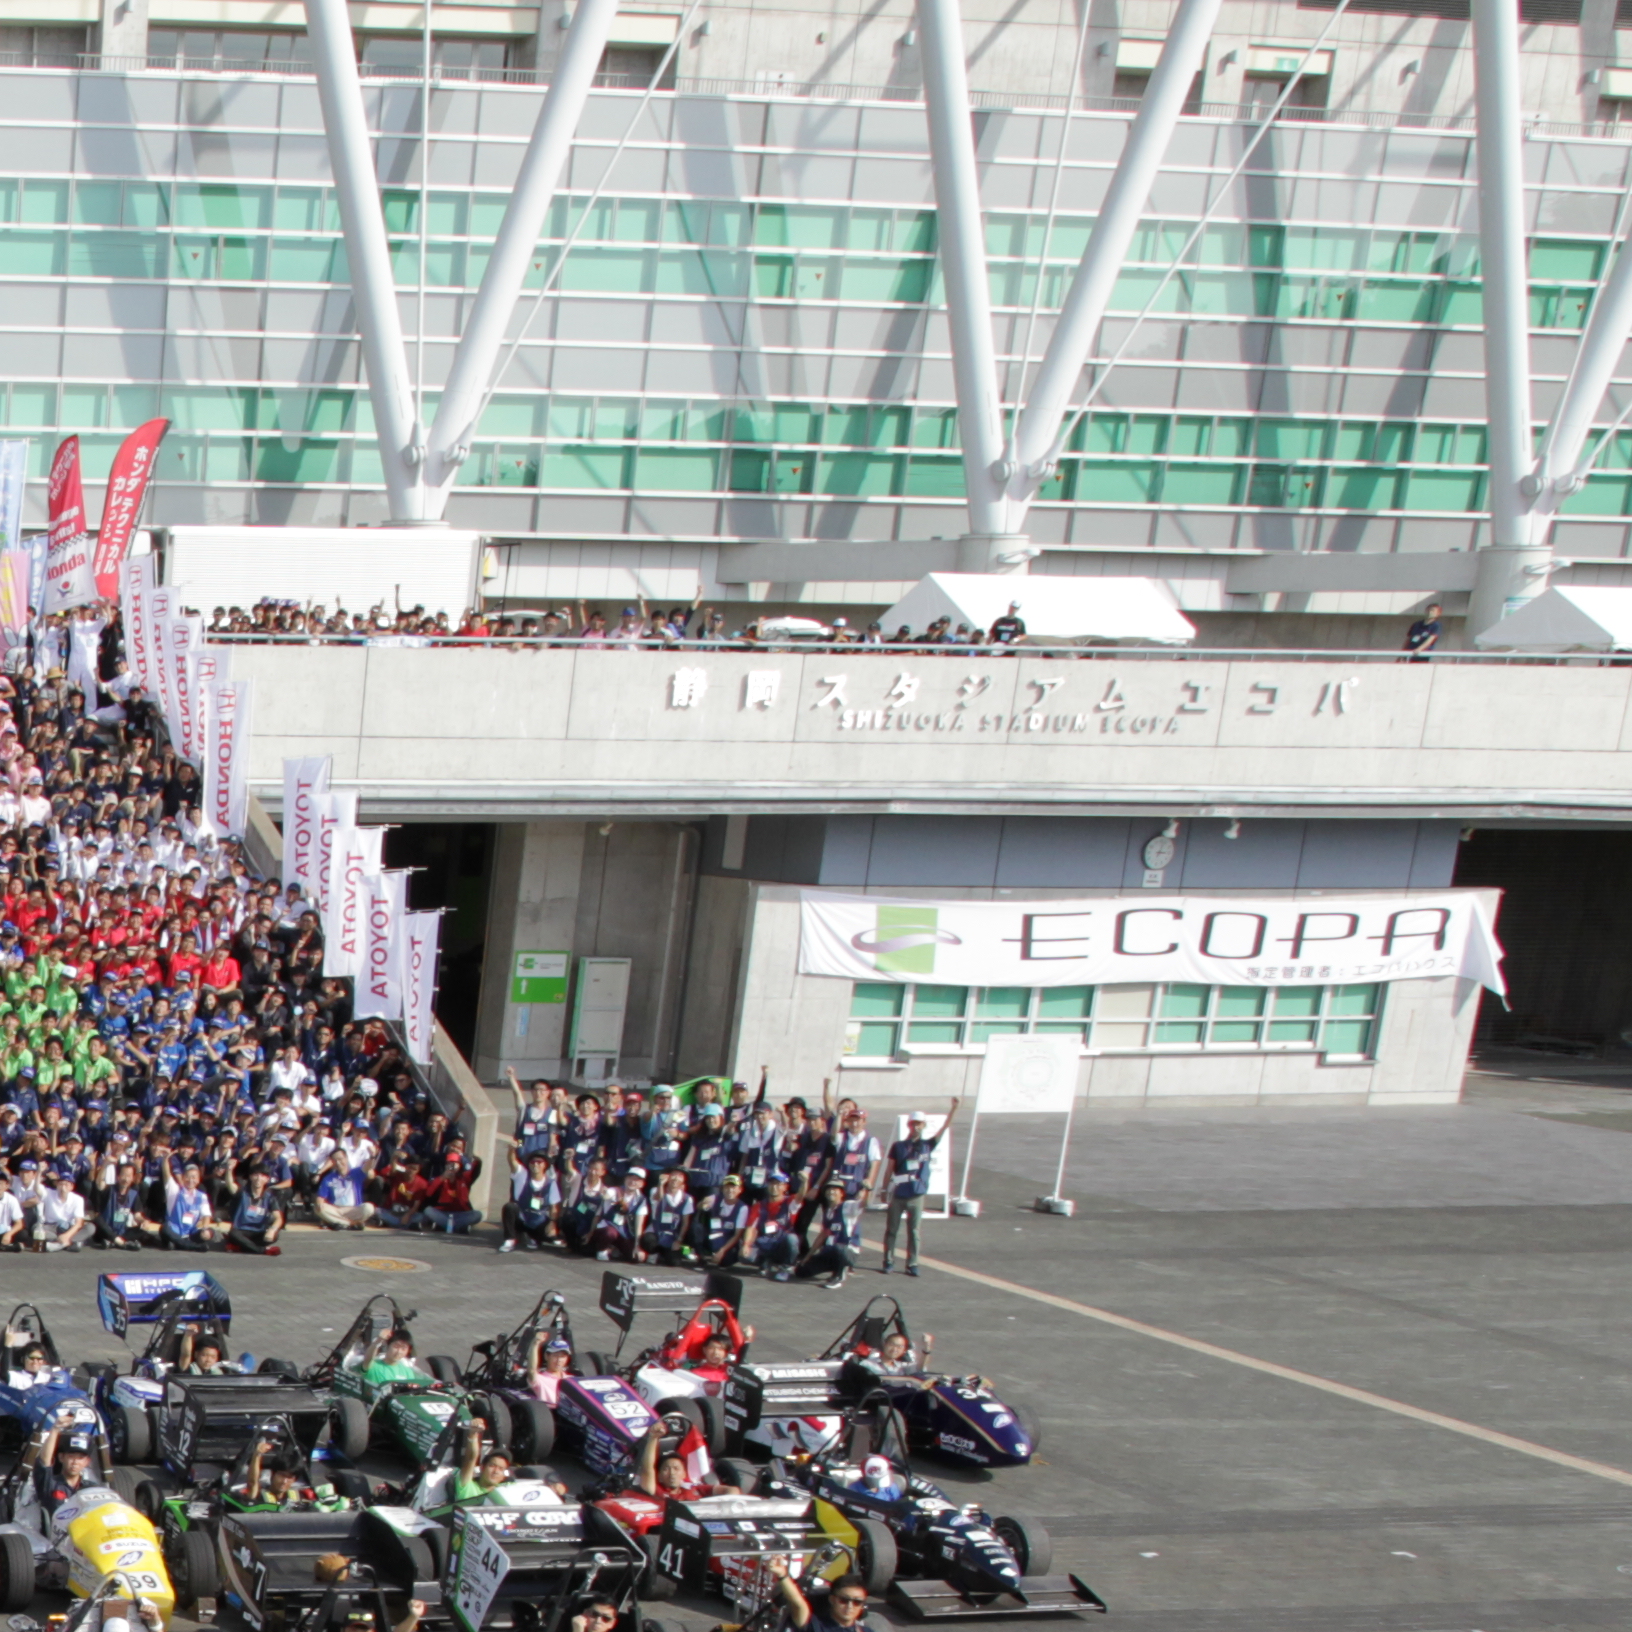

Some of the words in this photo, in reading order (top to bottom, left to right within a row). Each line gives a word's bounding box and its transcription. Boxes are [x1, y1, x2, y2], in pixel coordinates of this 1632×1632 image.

[125, 446, 149, 491] ホンダ
[102, 497, 134, 576] テクニカル
[839, 709, 965, 732] SHIZUOKA
[981, 711, 1088, 733] STADIUM
[1100, 714, 1180, 736] ECOPA
[1002, 907, 1452, 962] ECOPA
[610, 1401, 643, 1418] 52
[480, 1546, 502, 1581] 44
[660, 1543, 685, 1580] 41
